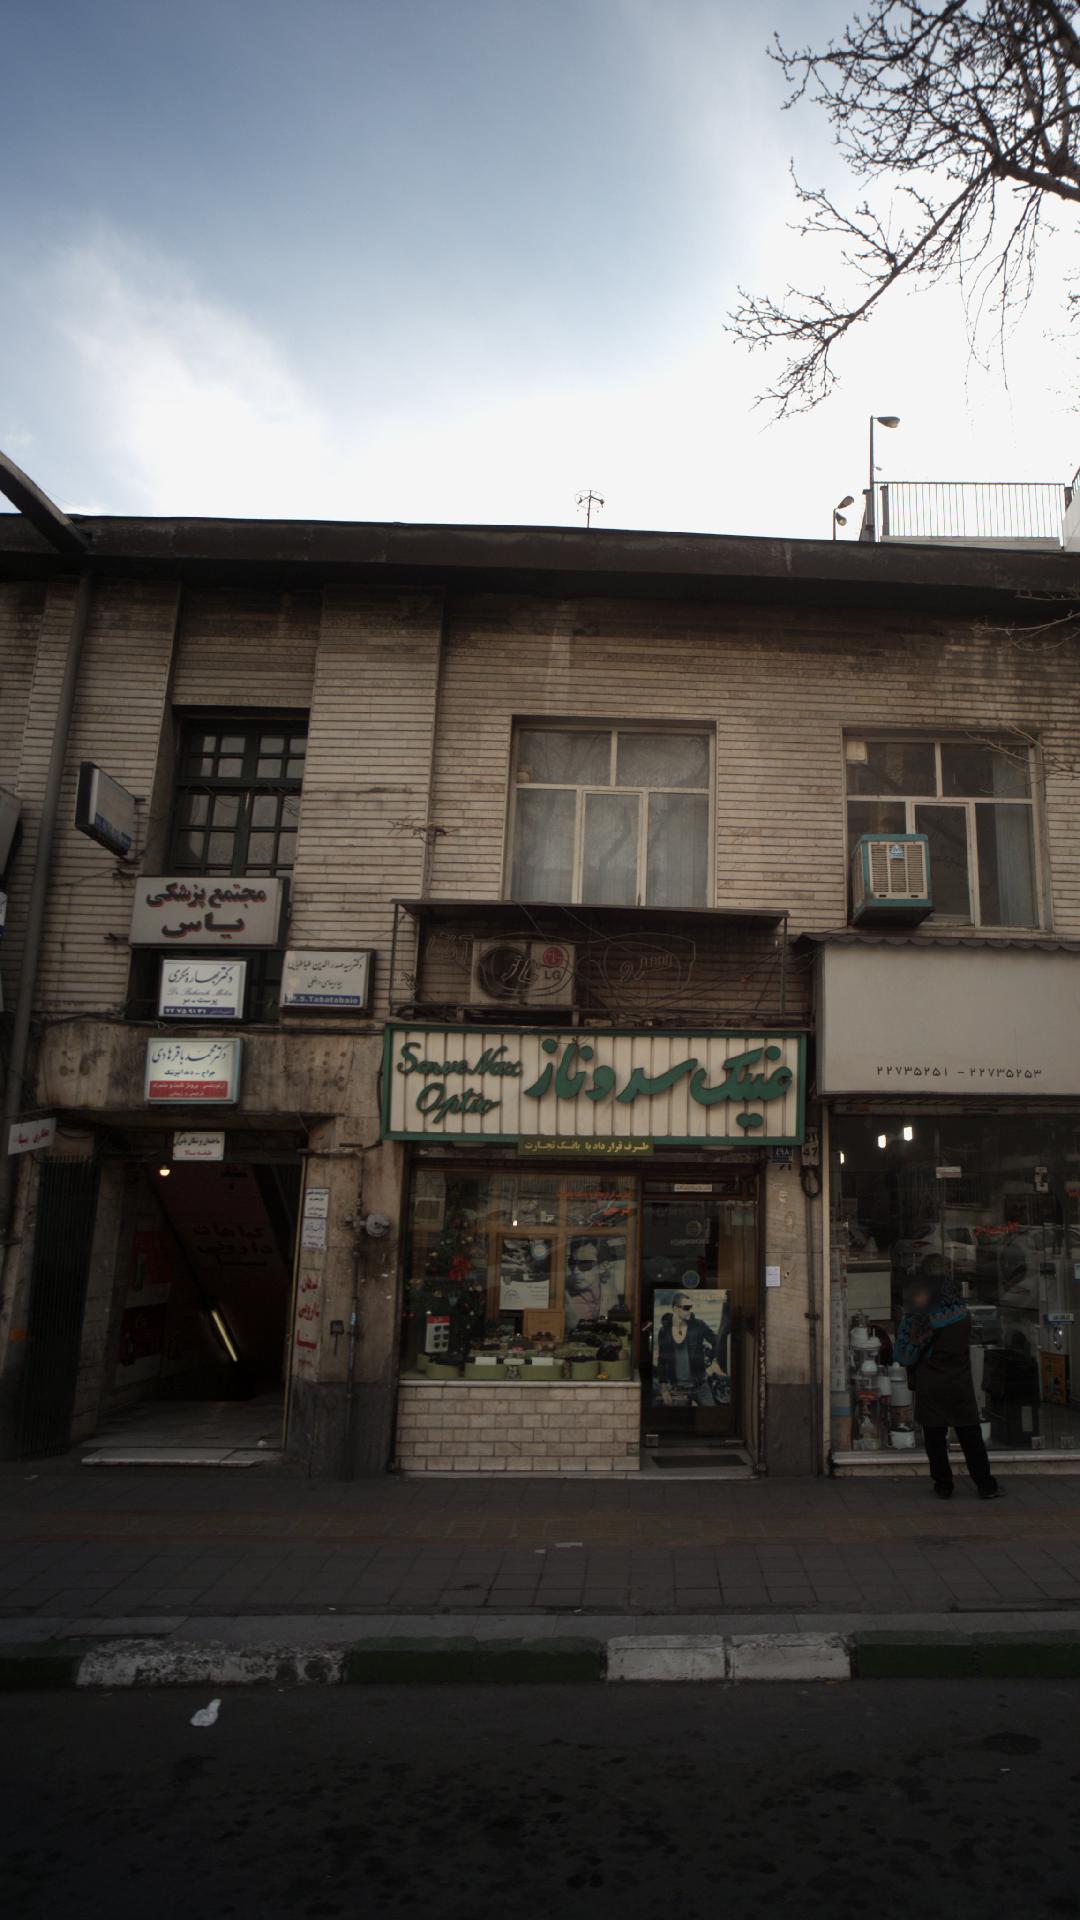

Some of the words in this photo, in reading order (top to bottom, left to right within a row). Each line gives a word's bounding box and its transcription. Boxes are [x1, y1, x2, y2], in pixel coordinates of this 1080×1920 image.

[146, 882, 206, 909] پزشکی
[207, 883, 267, 909] مجتمع
[161, 911, 245, 940] یاس
[545, 970, 562, 981] LG
[877, 1066, 948, 1077] ۲۲۷۳۵۲۵۱
[970, 1067, 1042, 1079] ۲۲۷۳۵۲۵۳
[690, 1045, 793, 1129] عینک
